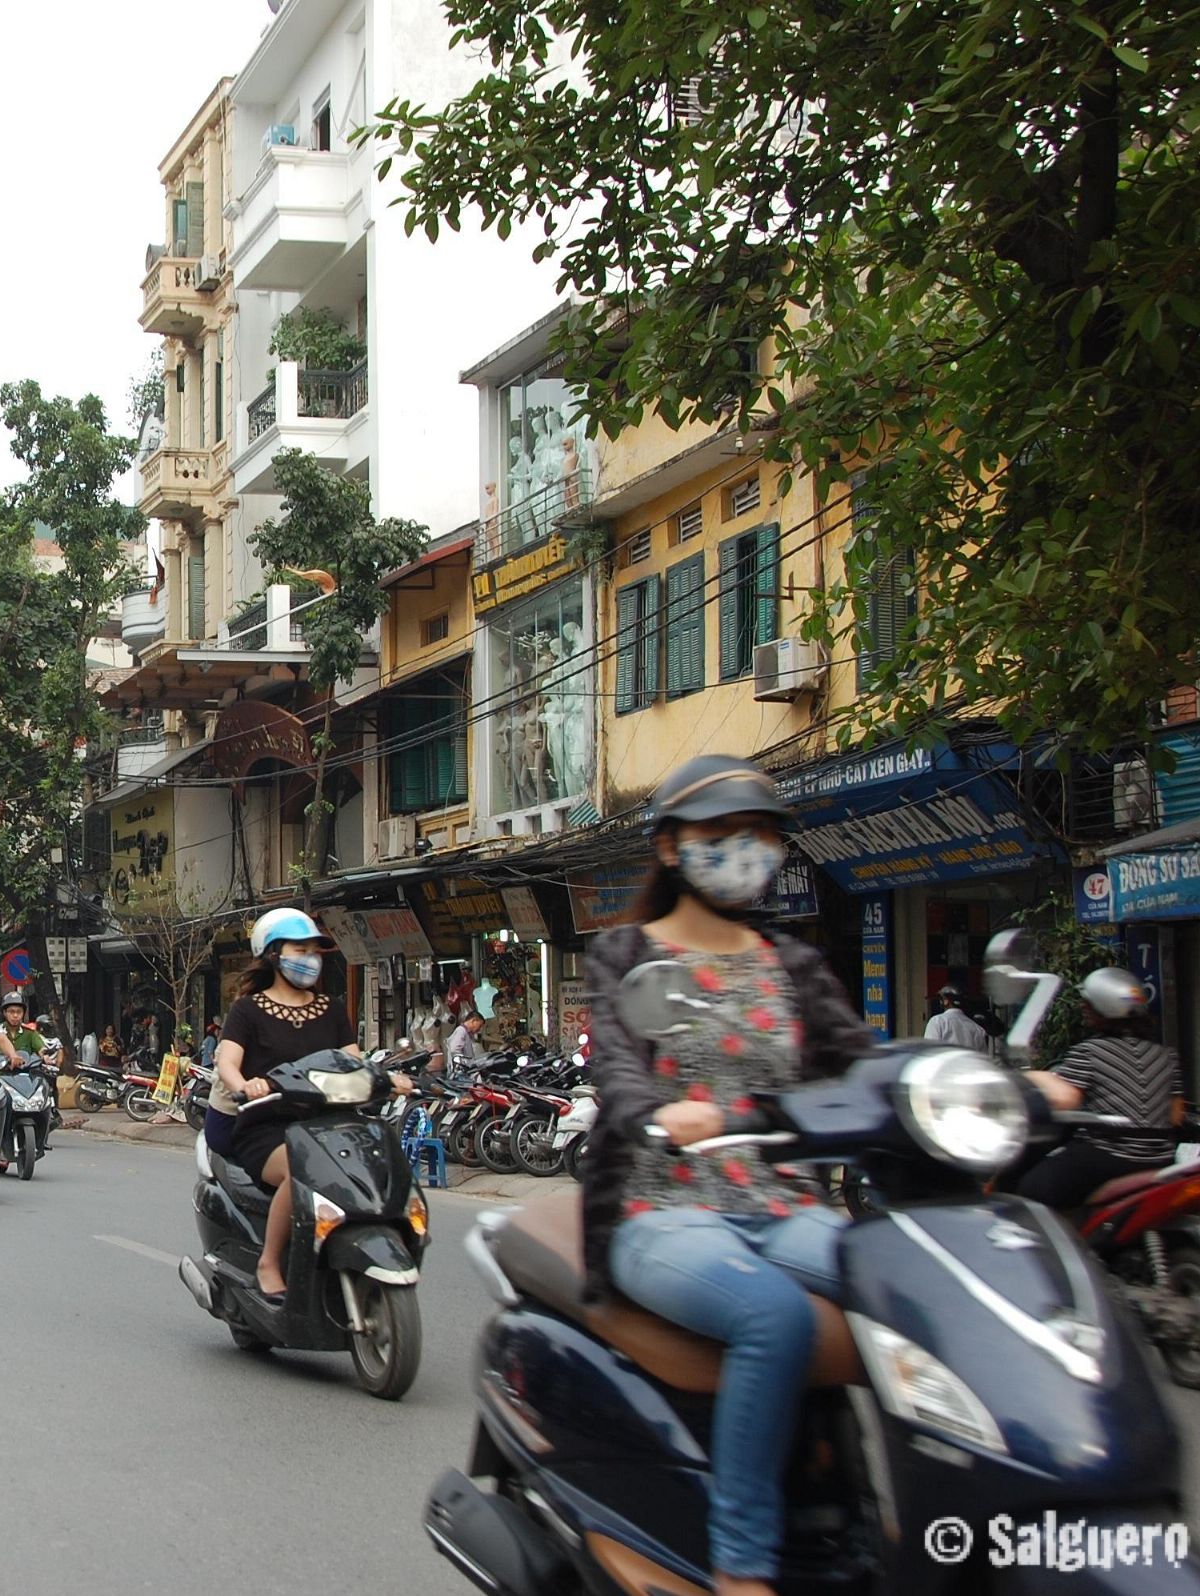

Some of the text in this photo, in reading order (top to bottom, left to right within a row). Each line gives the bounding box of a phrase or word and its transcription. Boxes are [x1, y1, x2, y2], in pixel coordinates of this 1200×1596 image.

[1088, 878, 1104, 896] 47
[864, 902, 883, 925] 45
[863, 959, 886, 977] Menu
